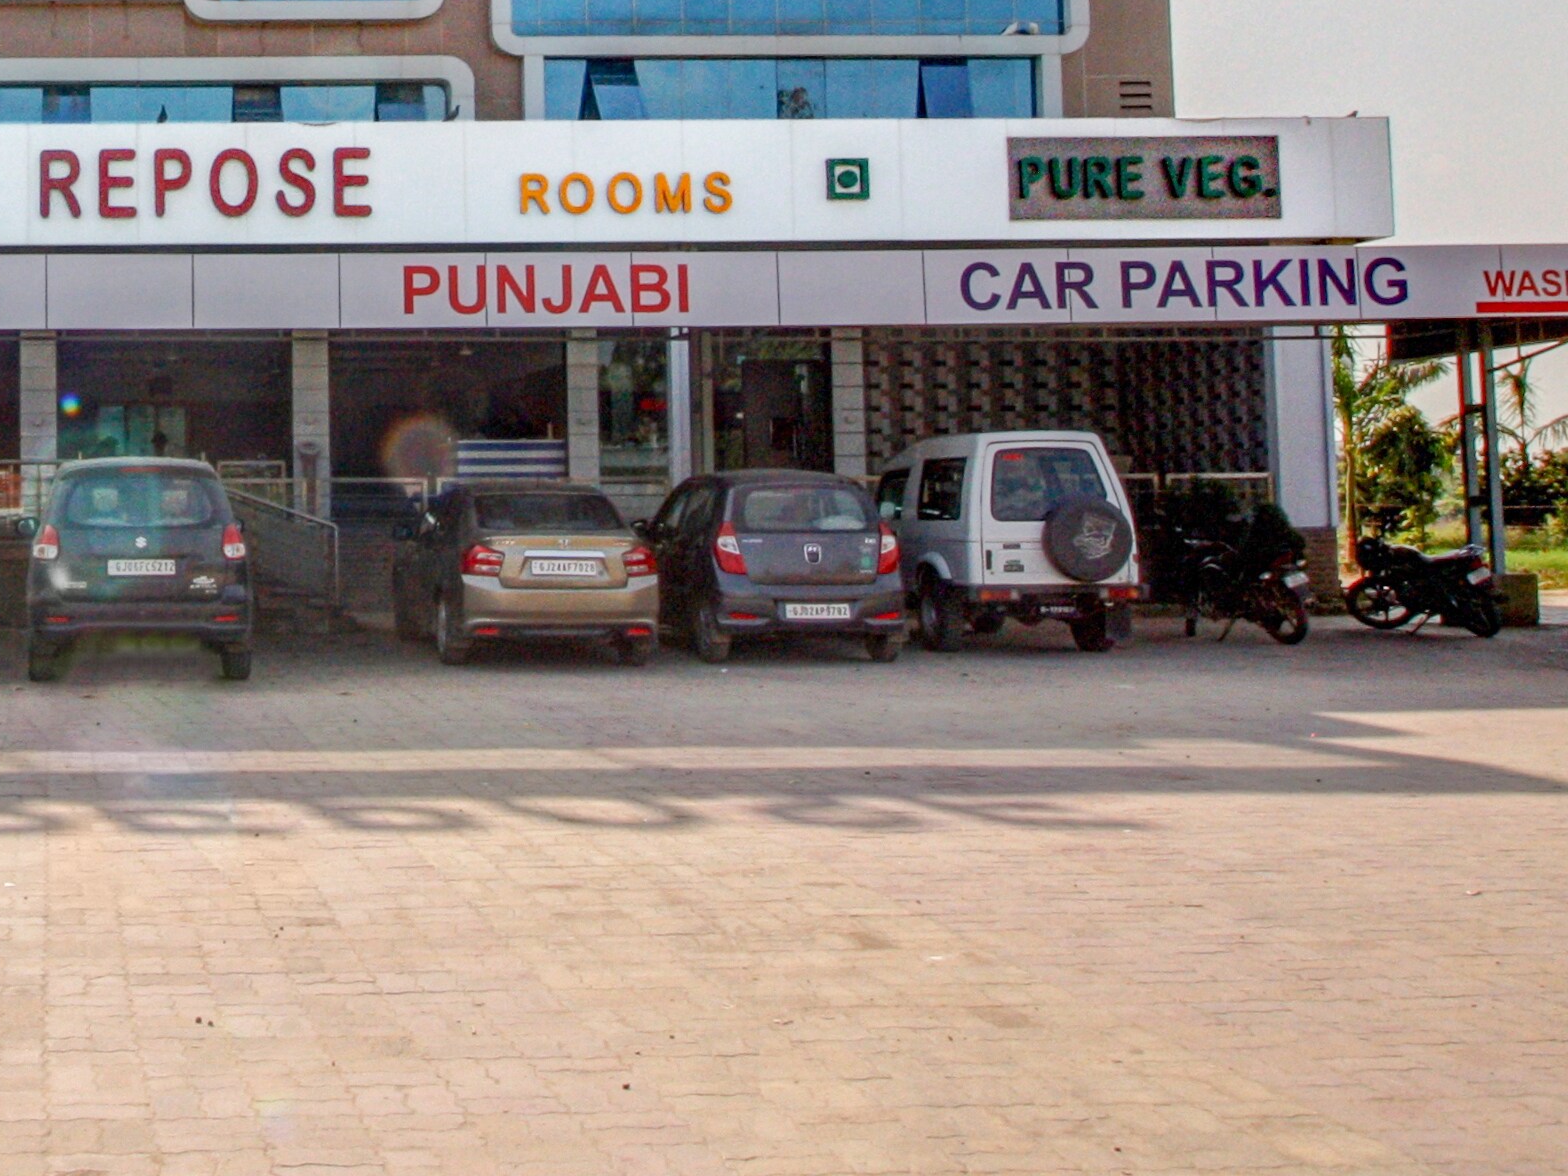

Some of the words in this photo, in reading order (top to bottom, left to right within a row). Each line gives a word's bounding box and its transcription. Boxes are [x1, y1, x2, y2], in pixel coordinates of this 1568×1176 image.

[40, 147, 373, 218] REPOSE
[519, 171, 733, 214] ROOMS
[1017, 155, 1145, 200] PURE
[1160, 154, 1277, 198] VEG.
[403, 264, 690, 315] PUNJABI
[959, 261, 1099, 311] CAR
[1119, 256, 1409, 309] PARKING
[1483, 269, 1568, 297] WAS
